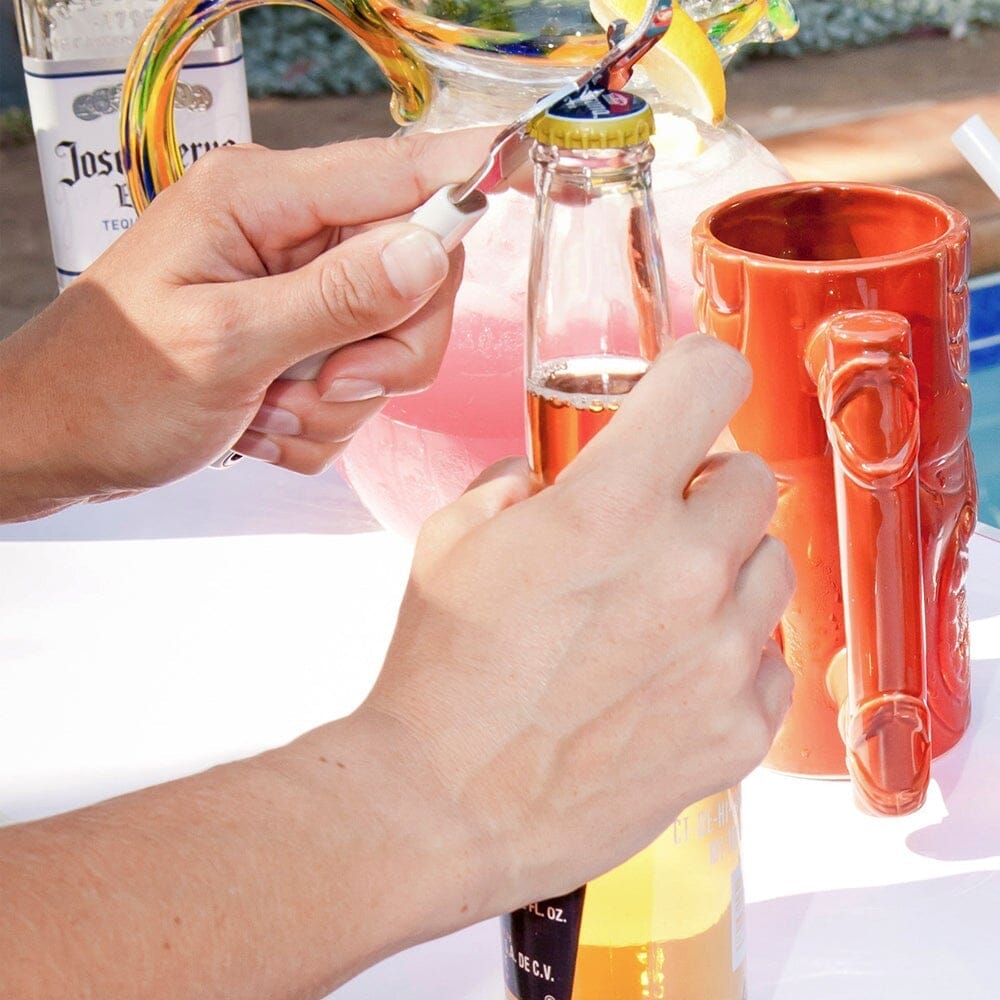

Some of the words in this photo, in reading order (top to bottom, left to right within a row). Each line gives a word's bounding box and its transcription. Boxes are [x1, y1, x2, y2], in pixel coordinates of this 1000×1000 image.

[547, 906, 567, 923] OZ.
[518, 951, 530, 972] DE
[532, 960, 554, 982] C.V.
